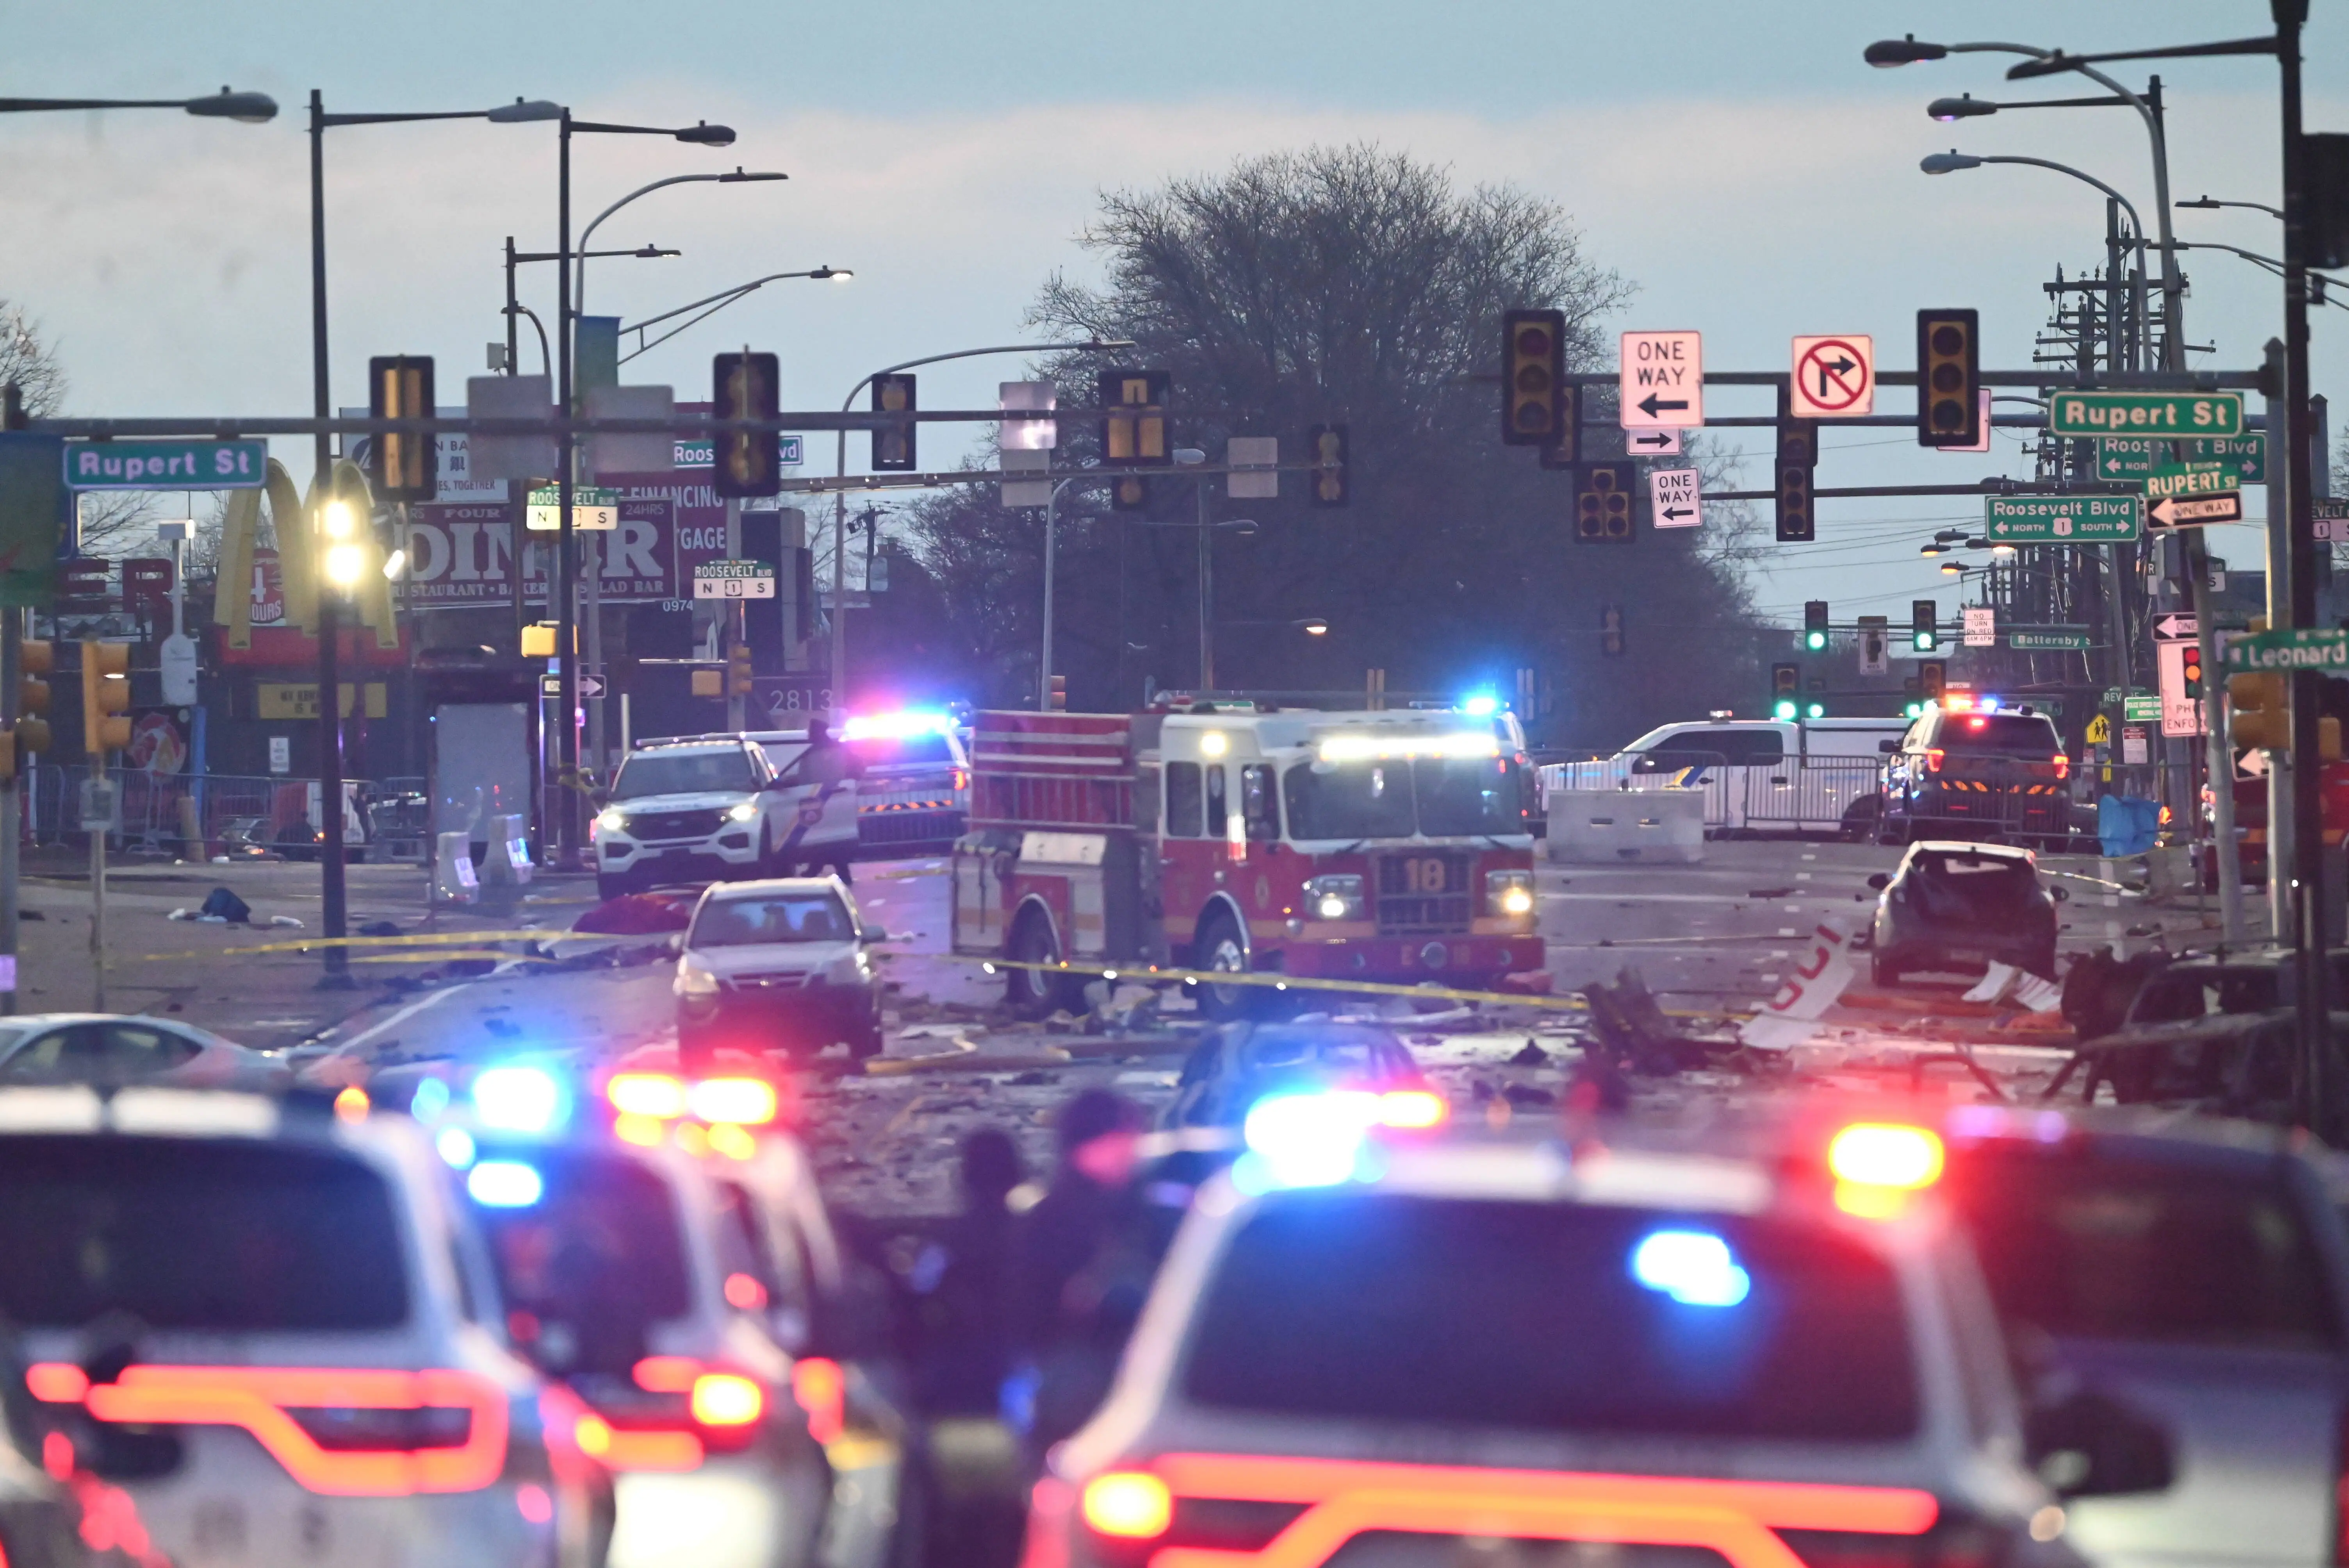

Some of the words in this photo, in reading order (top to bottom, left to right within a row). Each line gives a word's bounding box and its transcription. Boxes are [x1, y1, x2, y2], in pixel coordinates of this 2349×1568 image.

[1638, 341, 1684, 360] ONE
[1636, 367, 1685, 386] WAY
[2065, 400, 2177, 429] Rupert
[2193, 401, 2228, 426] St
[2214, 439, 2257, 455] Blvd
[79, 451, 196, 481] Rupert
[215, 448, 250, 476] St
[454, 480, 495, 490] TOGETHER
[1659, 474, 1691, 488] ONE
[2148, 471, 2221, 495] RUPERT
[529, 492, 595, 505] ROOSELT
[1659, 490, 1692, 504] WAY
[444, 508, 501, 519] FOUR
[626, 503, 665, 515] 24HRS
[1994, 501, 2083, 516] Roosevelt
[2091, 501, 2130, 515] Blvd
[2174, 503, 2201, 516] ONE
[2205, 501, 2231, 513] WAY
[2312, 506, 2344, 518] EVELT
[538, 511, 547, 522] N
[598, 512, 607, 523] S
[2061, 522, 2065, 532] 1
[681, 527, 725, 550] GAGE
[394, 520, 664, 581] DINR
[695, 566, 754, 577] ROOSEVELT
[580, 581, 627, 593] SLAD
[634, 581, 664, 593] BAR
[703, 583, 712, 593] N
[757, 583, 765, 593] S
[251, 599, 281, 621] OURS
[663, 600, 693, 612] 0974
[2018, 635, 2080, 647] Battersby
[2249, 640, 2346, 666] Leonard
[770, 689, 834, 712] 2813
[2104, 692, 2140, 702] REVE
[1405, 858, 1445, 891] 18
